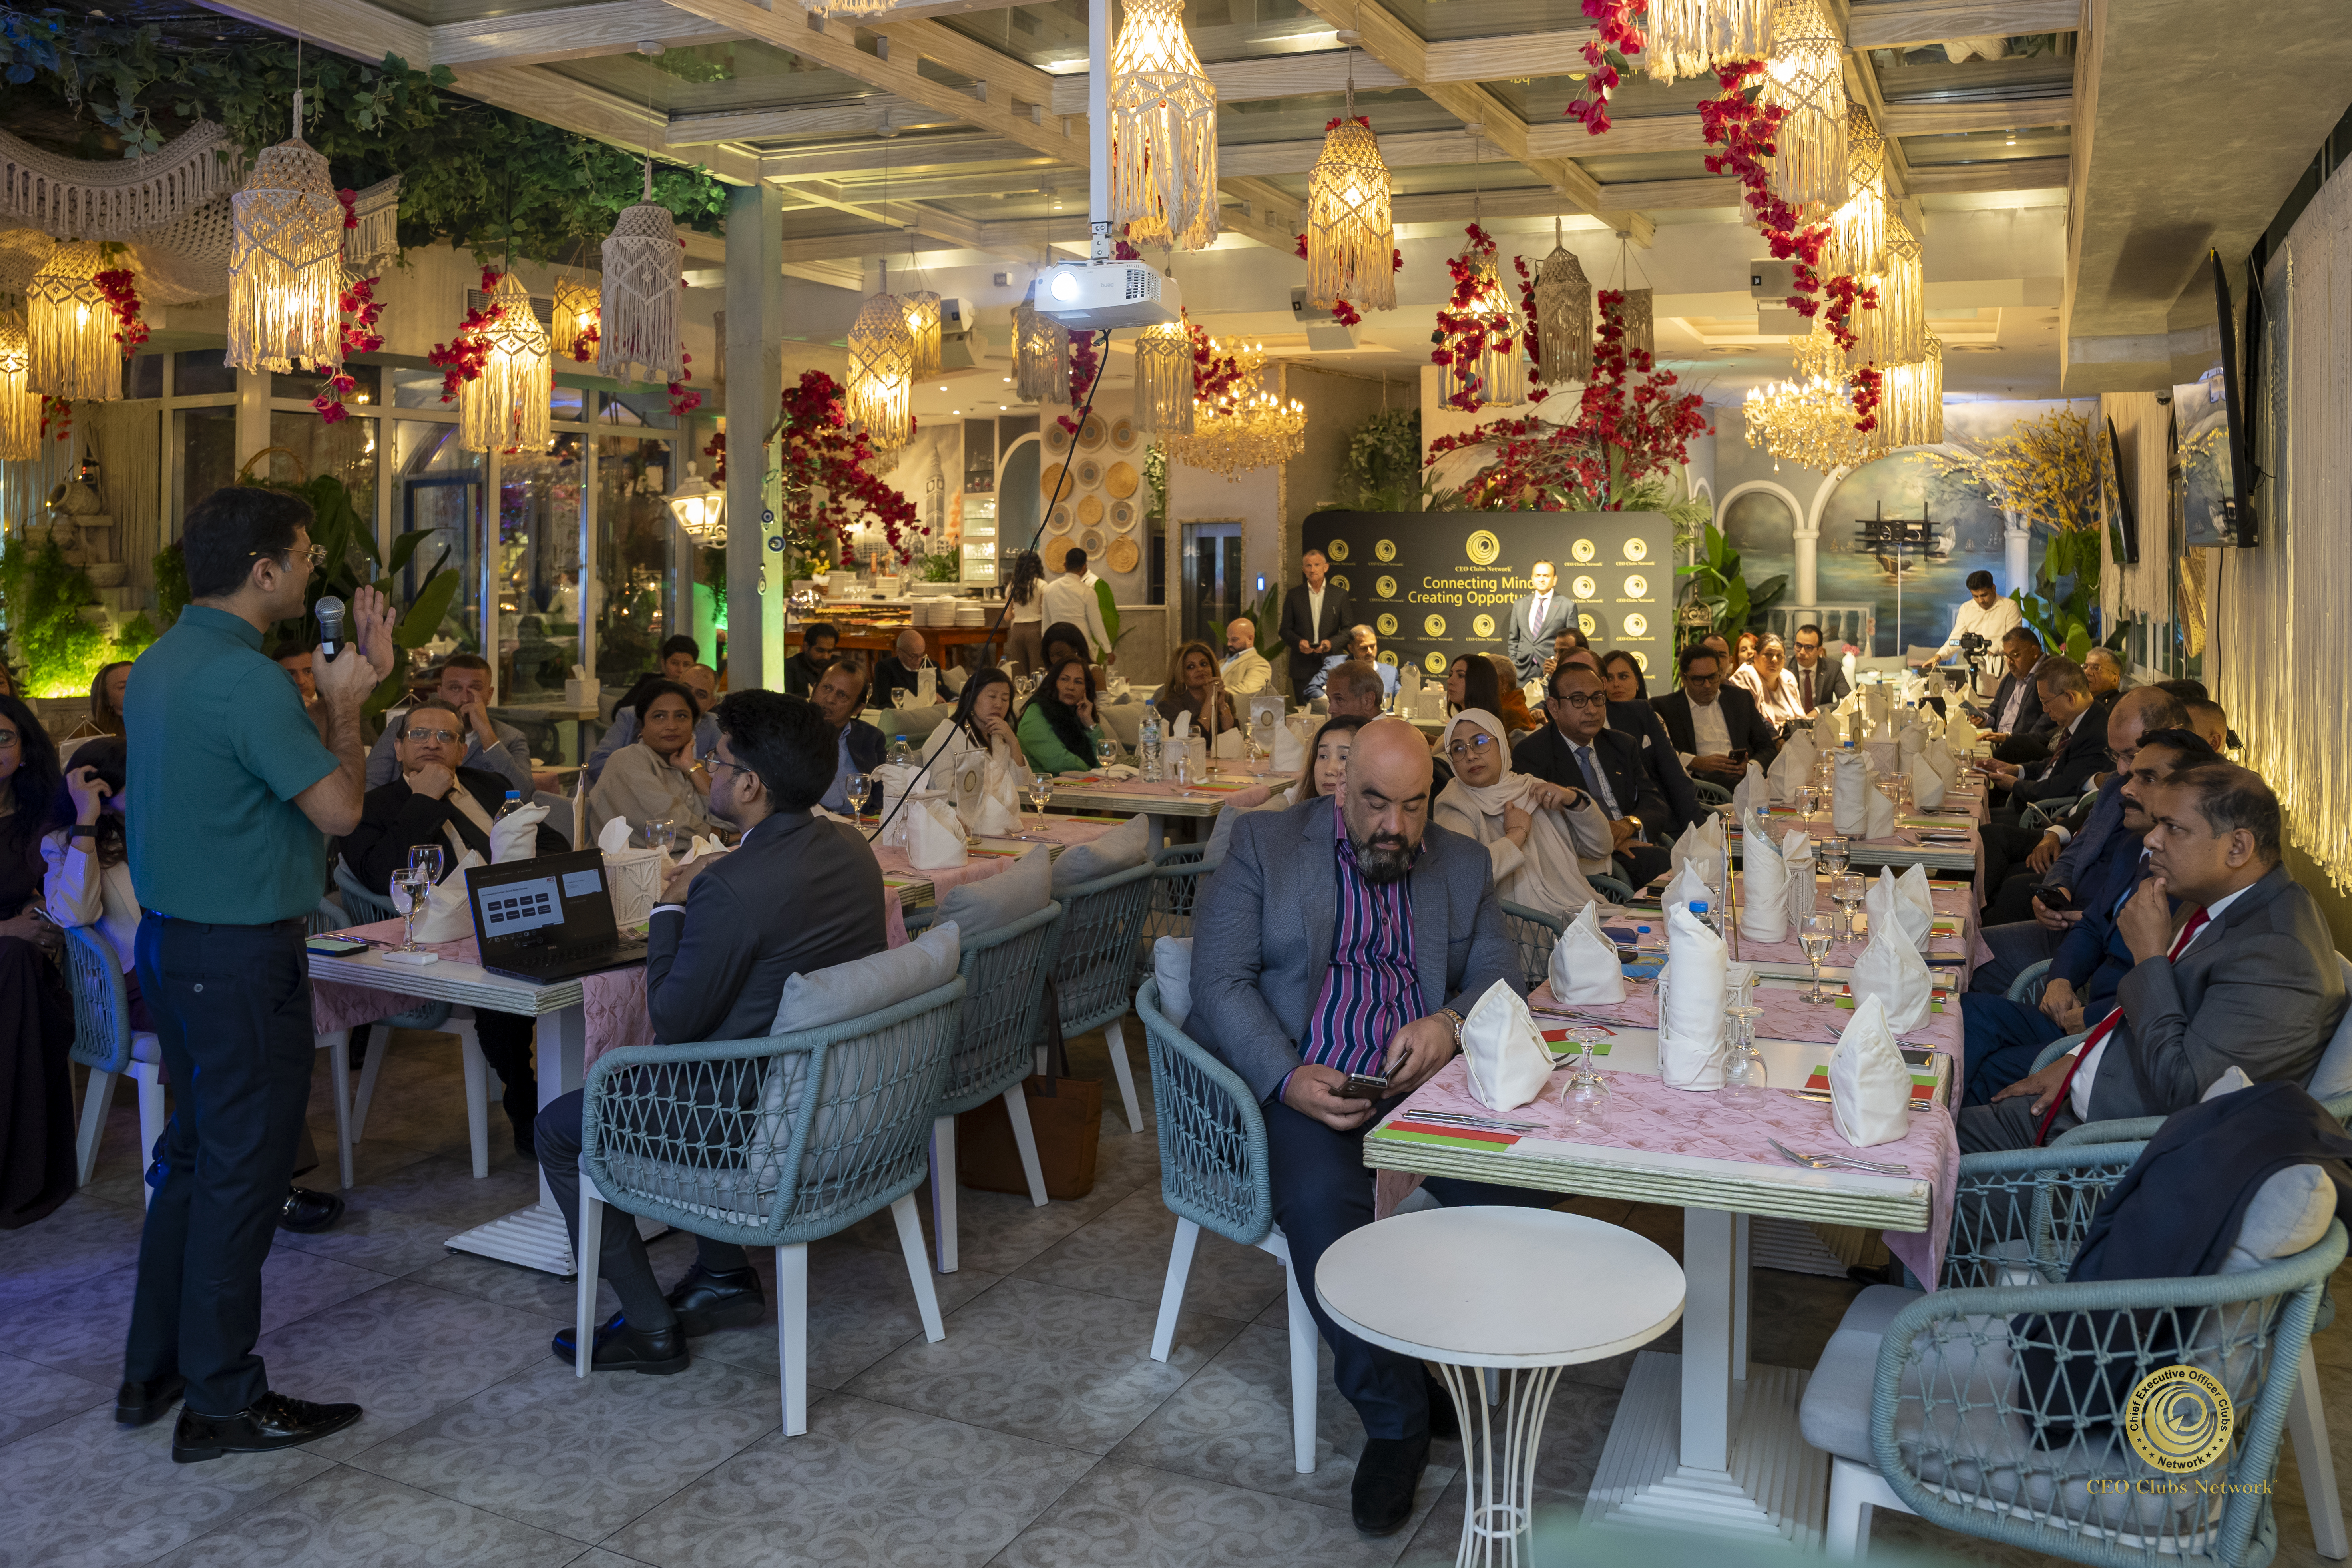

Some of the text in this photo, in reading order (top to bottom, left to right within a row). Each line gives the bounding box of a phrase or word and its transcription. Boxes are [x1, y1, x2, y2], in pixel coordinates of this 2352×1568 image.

[1423, 576, 1534, 592] Connecting Mind
[1408, 591, 1462, 607] Creating
